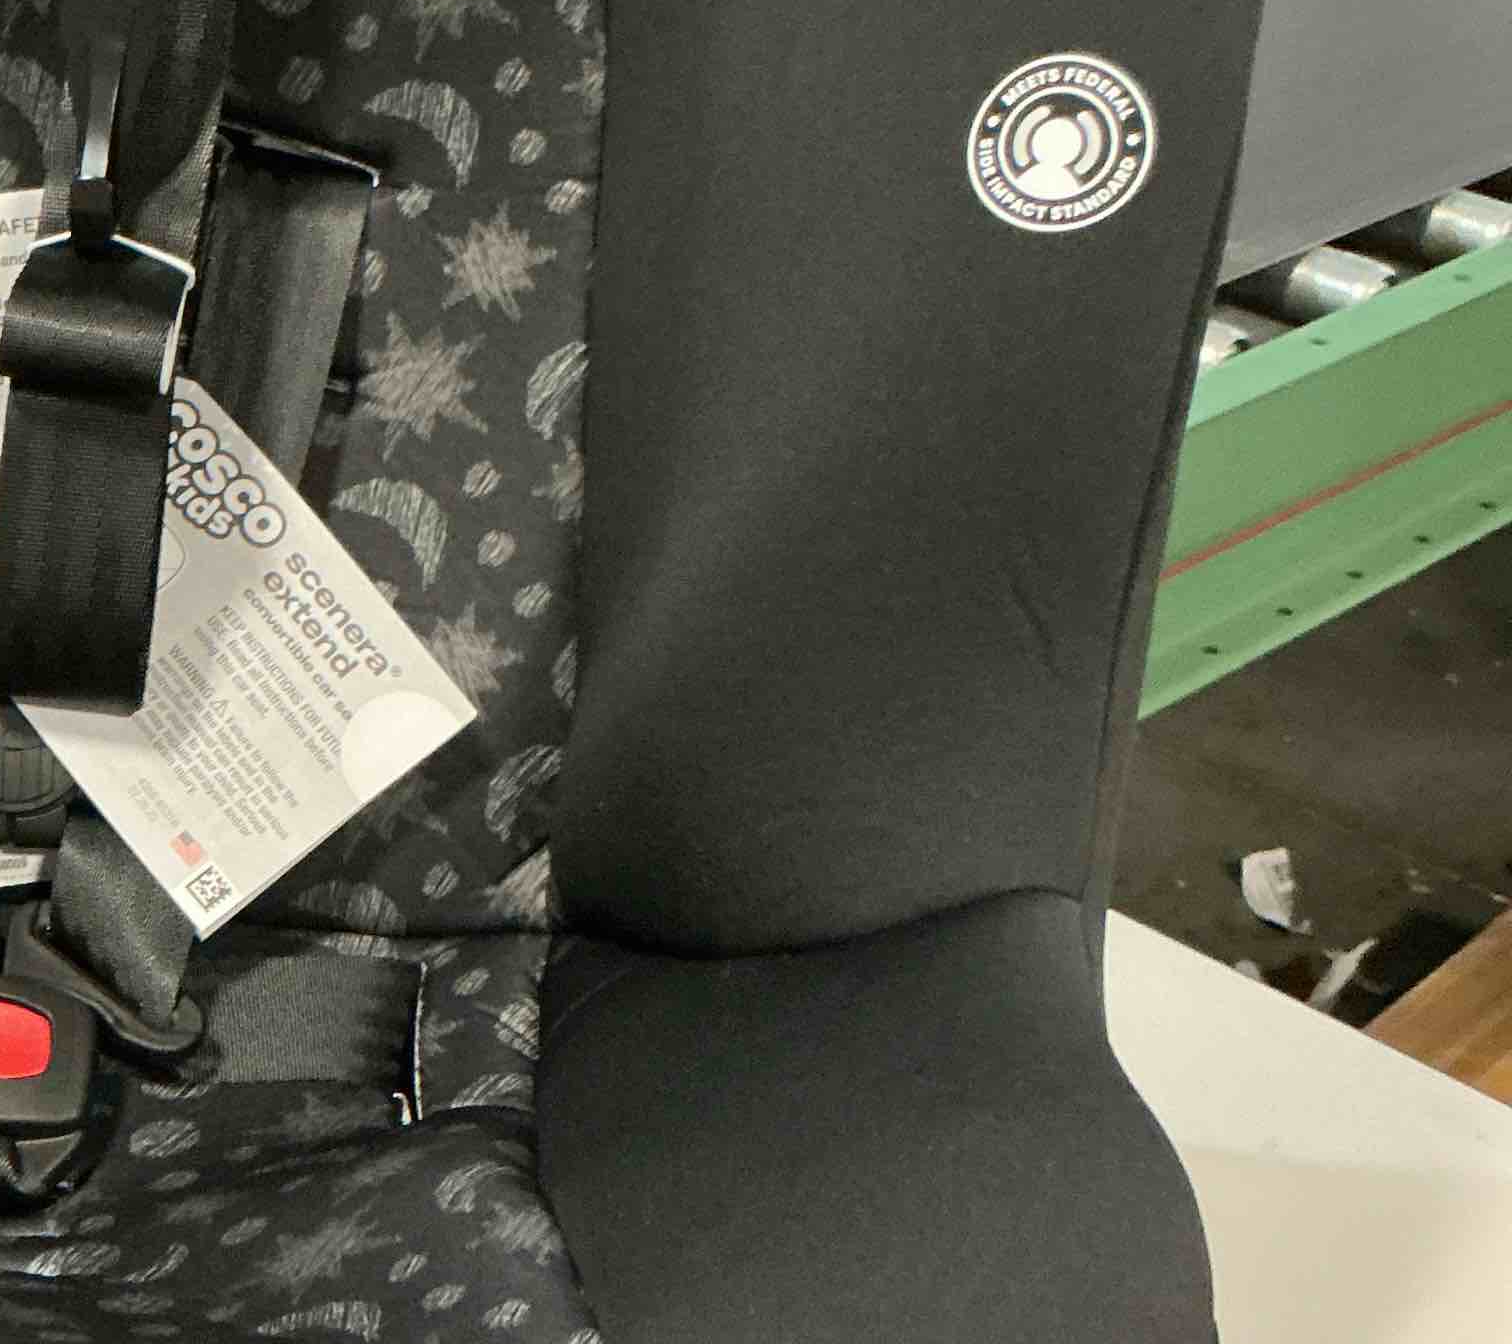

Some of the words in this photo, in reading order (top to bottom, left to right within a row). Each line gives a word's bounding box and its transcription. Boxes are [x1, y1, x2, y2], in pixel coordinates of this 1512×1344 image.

[1001, 67, 1061, 107] MEETS
[1063, 67, 1136, 121] FEDERAL
[986, 176, 1049, 219] IMPACT
[1050, 156, 1137, 221] STANDARD
[263, 569, 357, 679] extend
